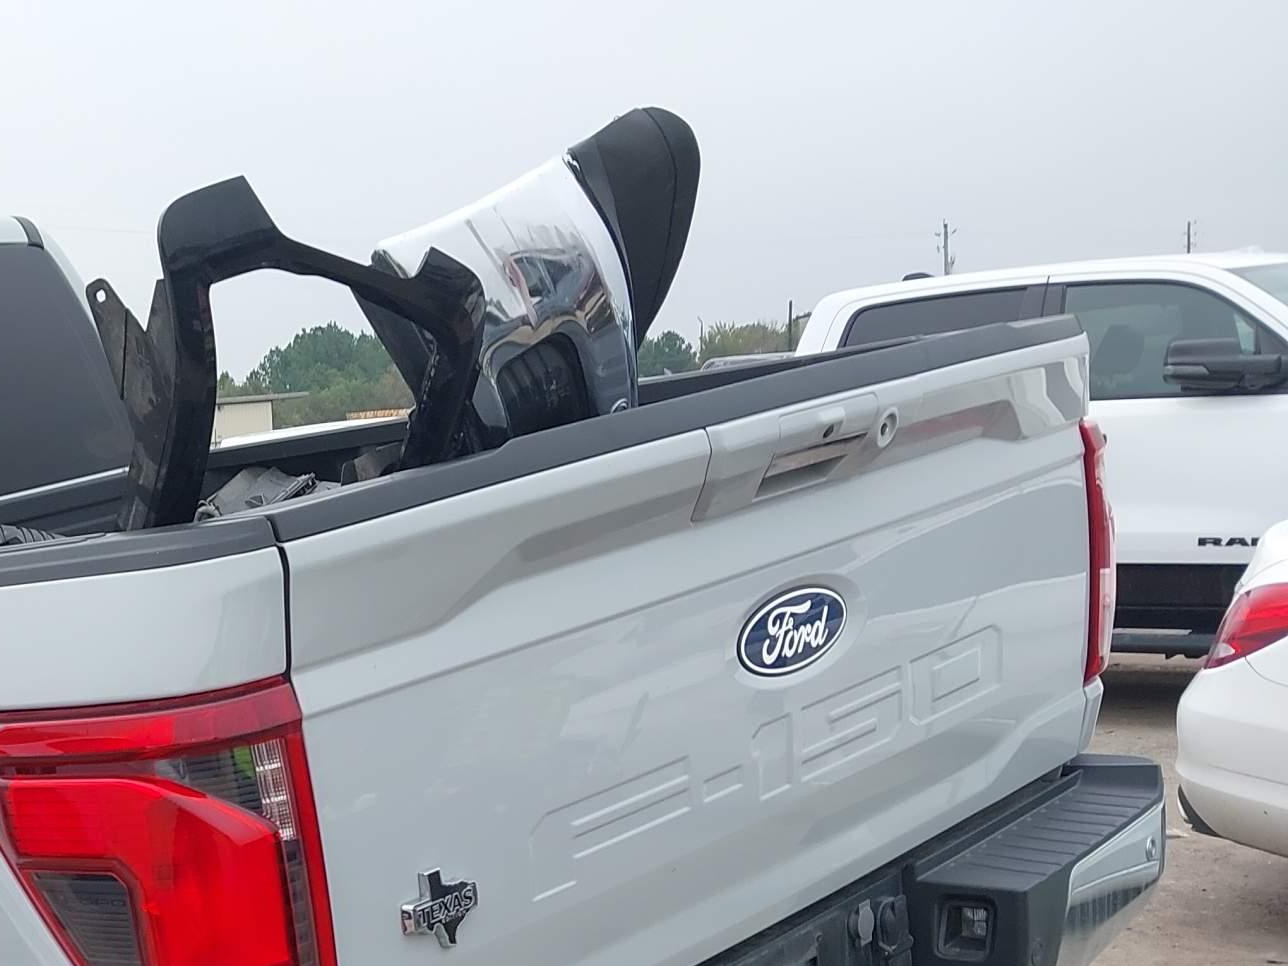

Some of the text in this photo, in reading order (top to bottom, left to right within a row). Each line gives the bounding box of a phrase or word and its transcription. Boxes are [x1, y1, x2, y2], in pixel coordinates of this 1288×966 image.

[762, 599, 829, 665] Ford
[528, 622, 1003, 902] F-150
[414, 885, 476, 927] TEXAS
